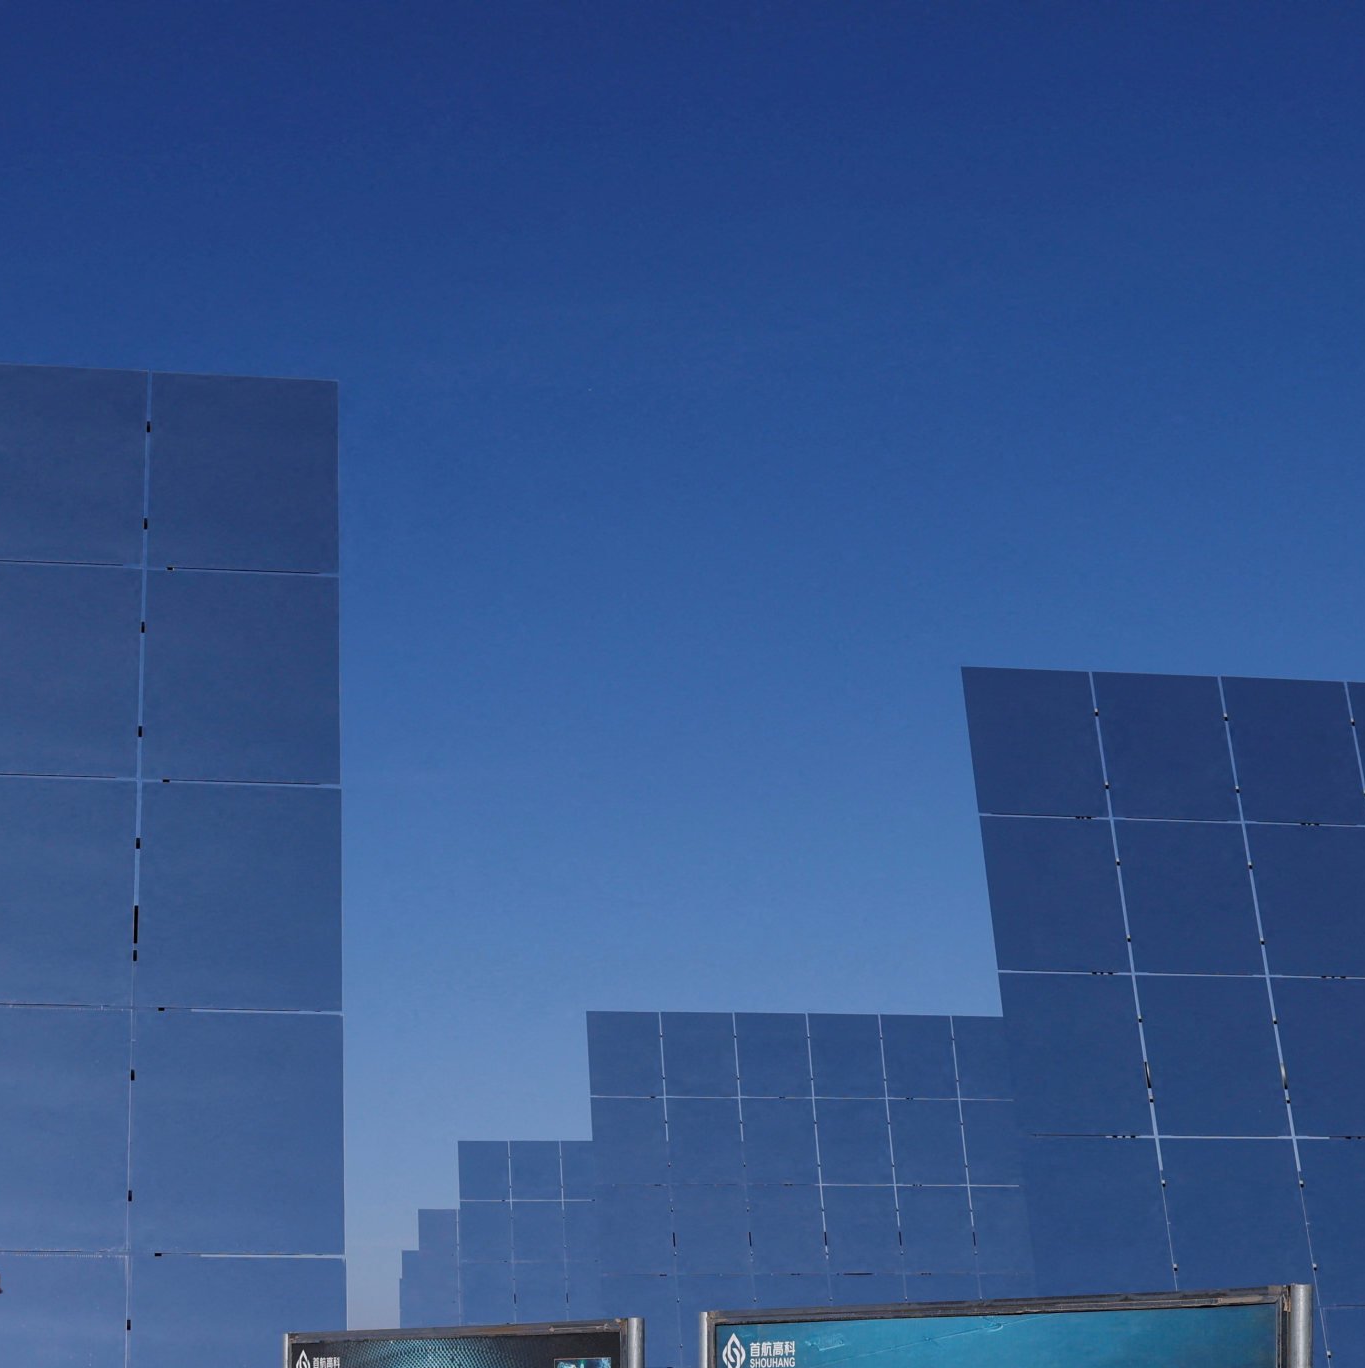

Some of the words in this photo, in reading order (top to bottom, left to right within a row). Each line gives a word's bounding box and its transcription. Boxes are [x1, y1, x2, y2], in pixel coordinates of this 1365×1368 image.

[750, 1341, 795, 1357] 首航高科
[750, 1357, 795, 1368] SHOUHANG
